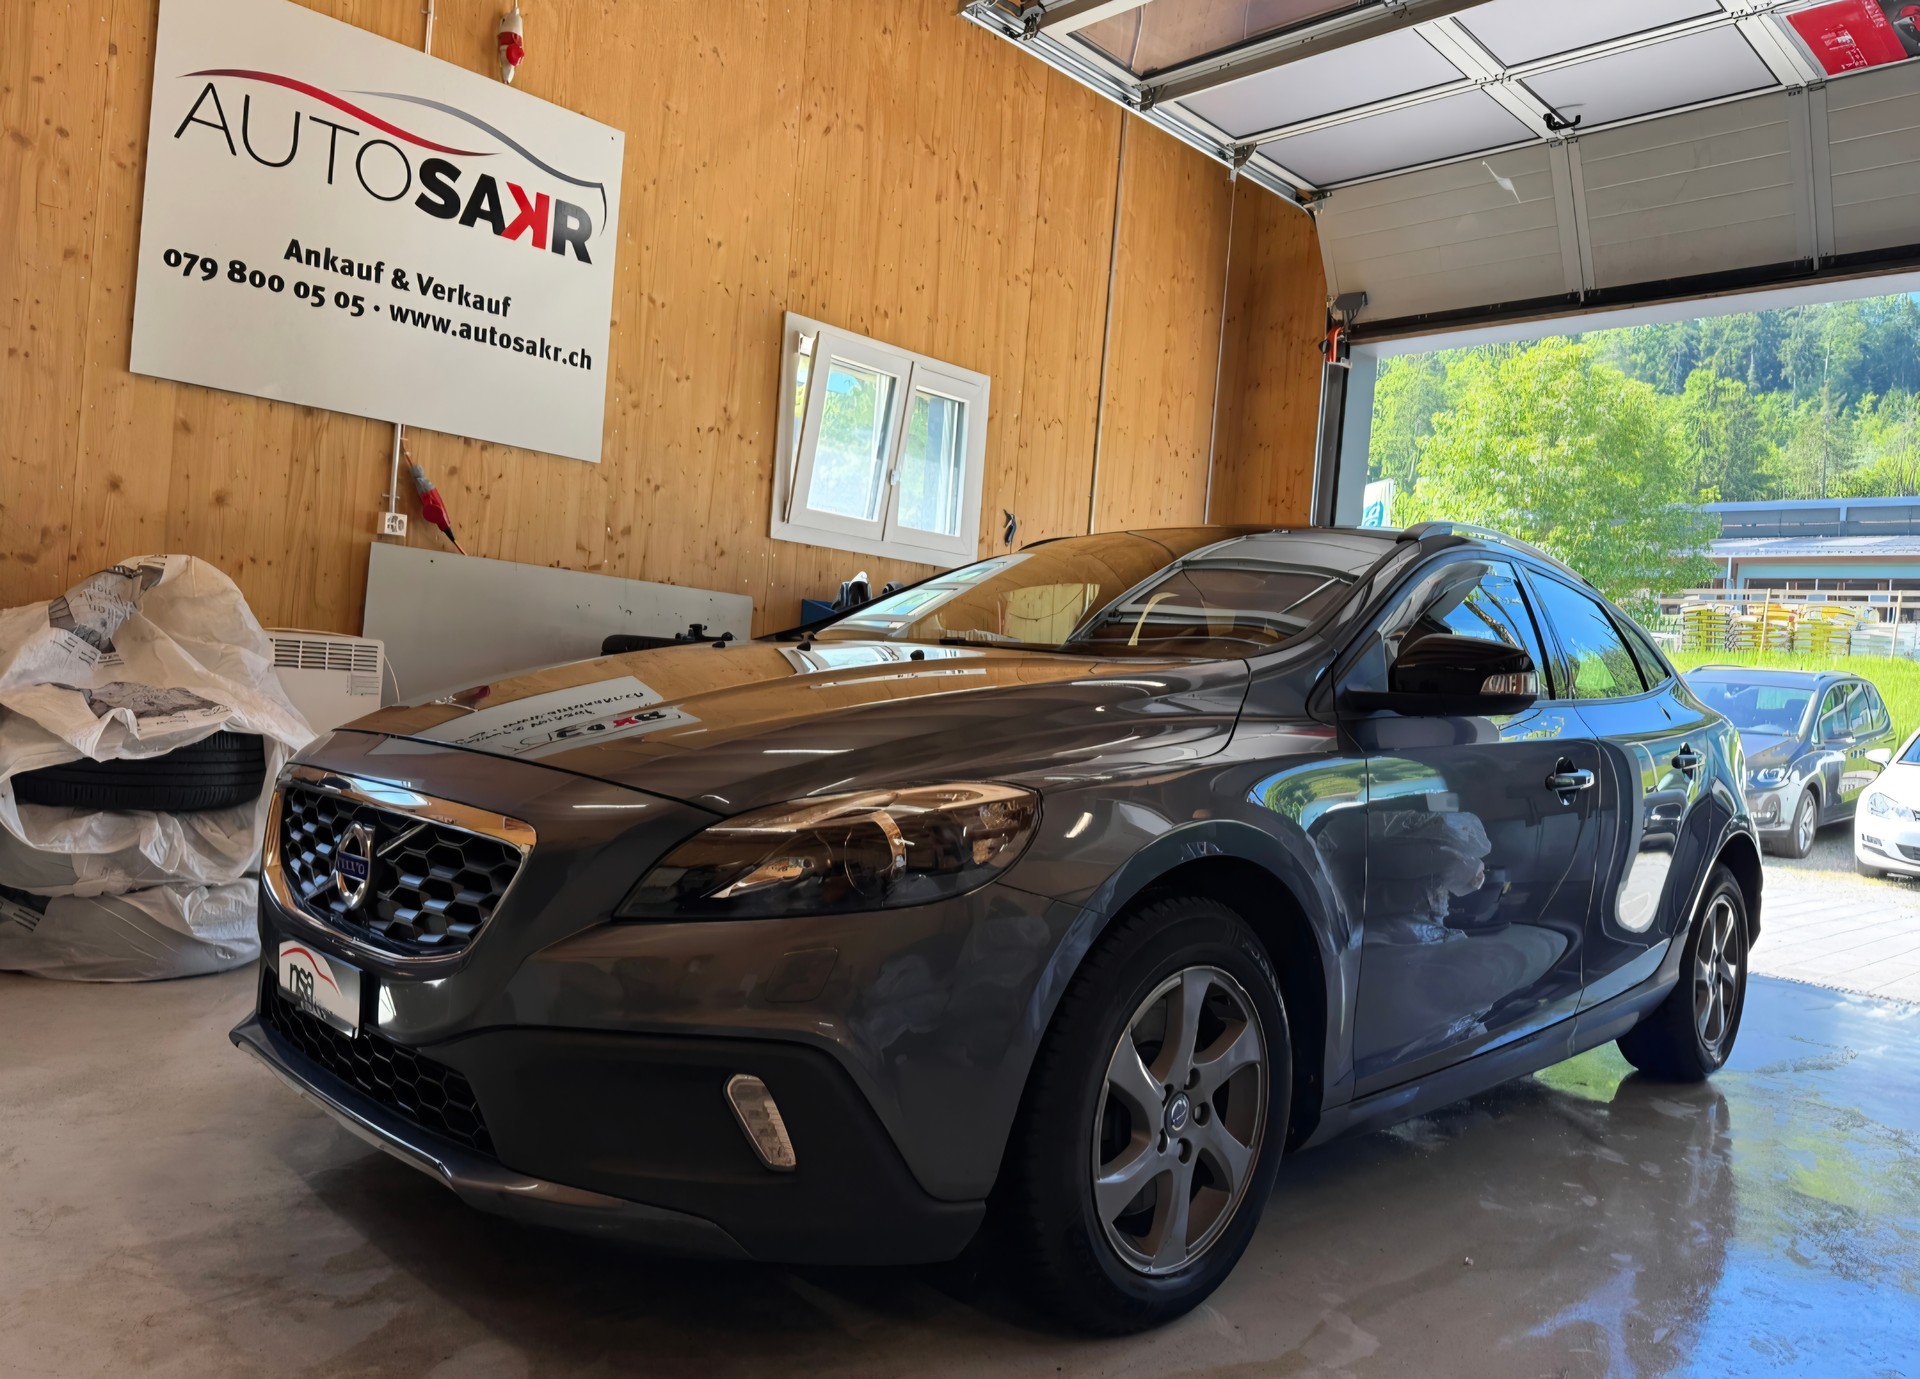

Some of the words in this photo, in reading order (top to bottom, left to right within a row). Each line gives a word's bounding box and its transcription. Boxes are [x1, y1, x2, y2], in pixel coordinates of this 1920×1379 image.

[174, 82, 593, 265] AUTOSAKR
[163, 249, 218, 281] 079
[227, 260, 285, 293] 800
[293, 280, 326, 307] 05
[334, 289, 365, 317] 05
[389, 303, 592, 370] www.autosakr.ch
[284, 239, 385, 284] Ankauf
[391, 268, 410, 291] &
[416, 273, 512, 318] Verkauf
